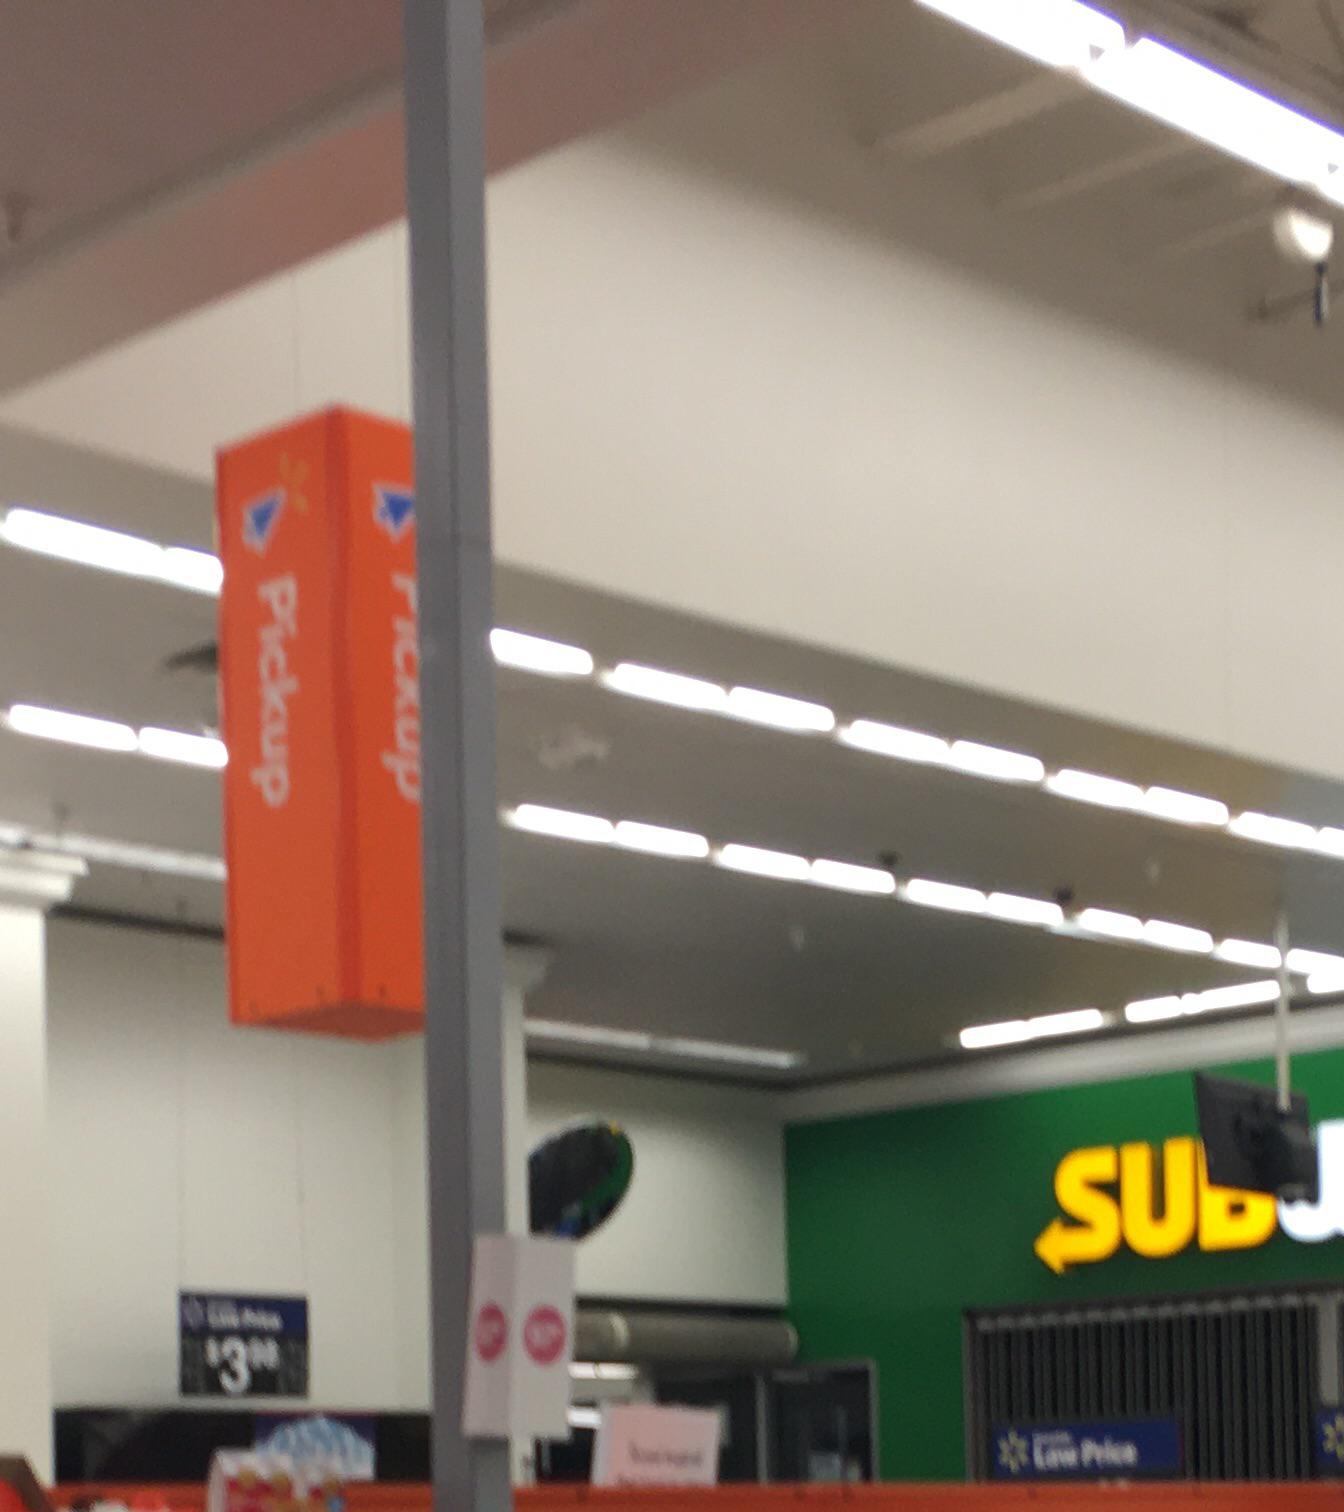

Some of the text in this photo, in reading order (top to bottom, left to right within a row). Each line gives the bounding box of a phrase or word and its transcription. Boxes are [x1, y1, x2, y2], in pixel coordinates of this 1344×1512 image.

[250, 573, 299, 808] Pickup
[1032, 1431, 1138, 1469] Low Price
